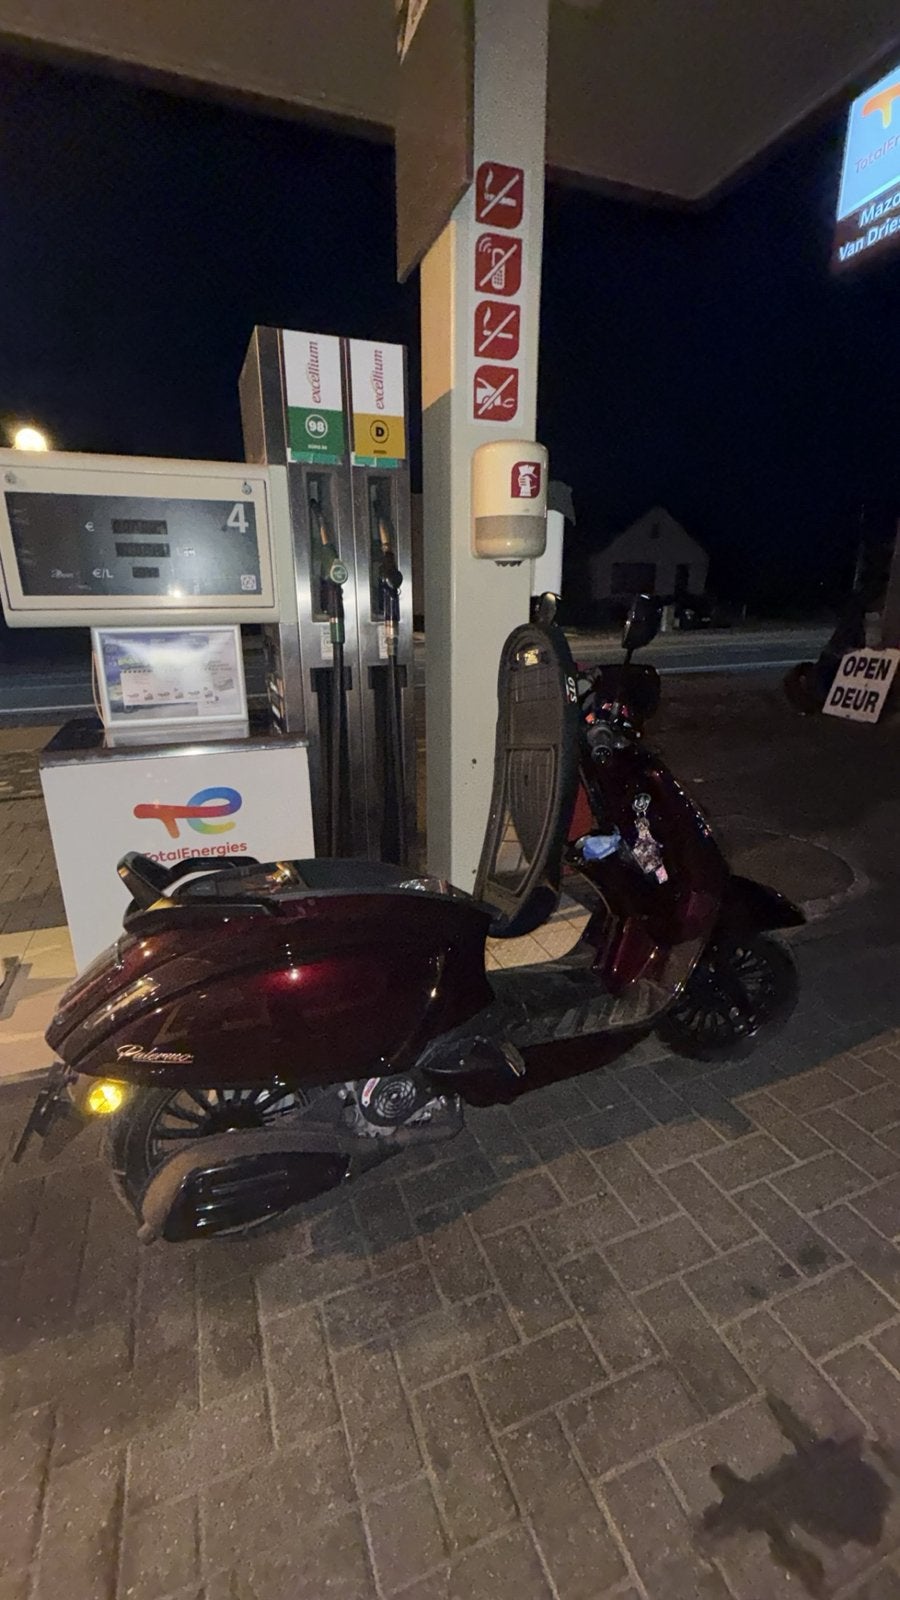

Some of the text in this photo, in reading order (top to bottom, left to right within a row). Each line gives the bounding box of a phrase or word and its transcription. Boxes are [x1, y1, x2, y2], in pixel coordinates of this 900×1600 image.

[839, 213, 900, 262] Van Drie
[306, 341, 322, 404] excellium
[371, 349, 385, 410] excellium
[308, 420, 325, 433] 98
[375, 426, 385, 438] D
[84, 521, 95, 532] €
[226, 502, 249, 534] 4
[842, 656, 892, 681] OPEN
[829, 686, 880, 713] DEUR
